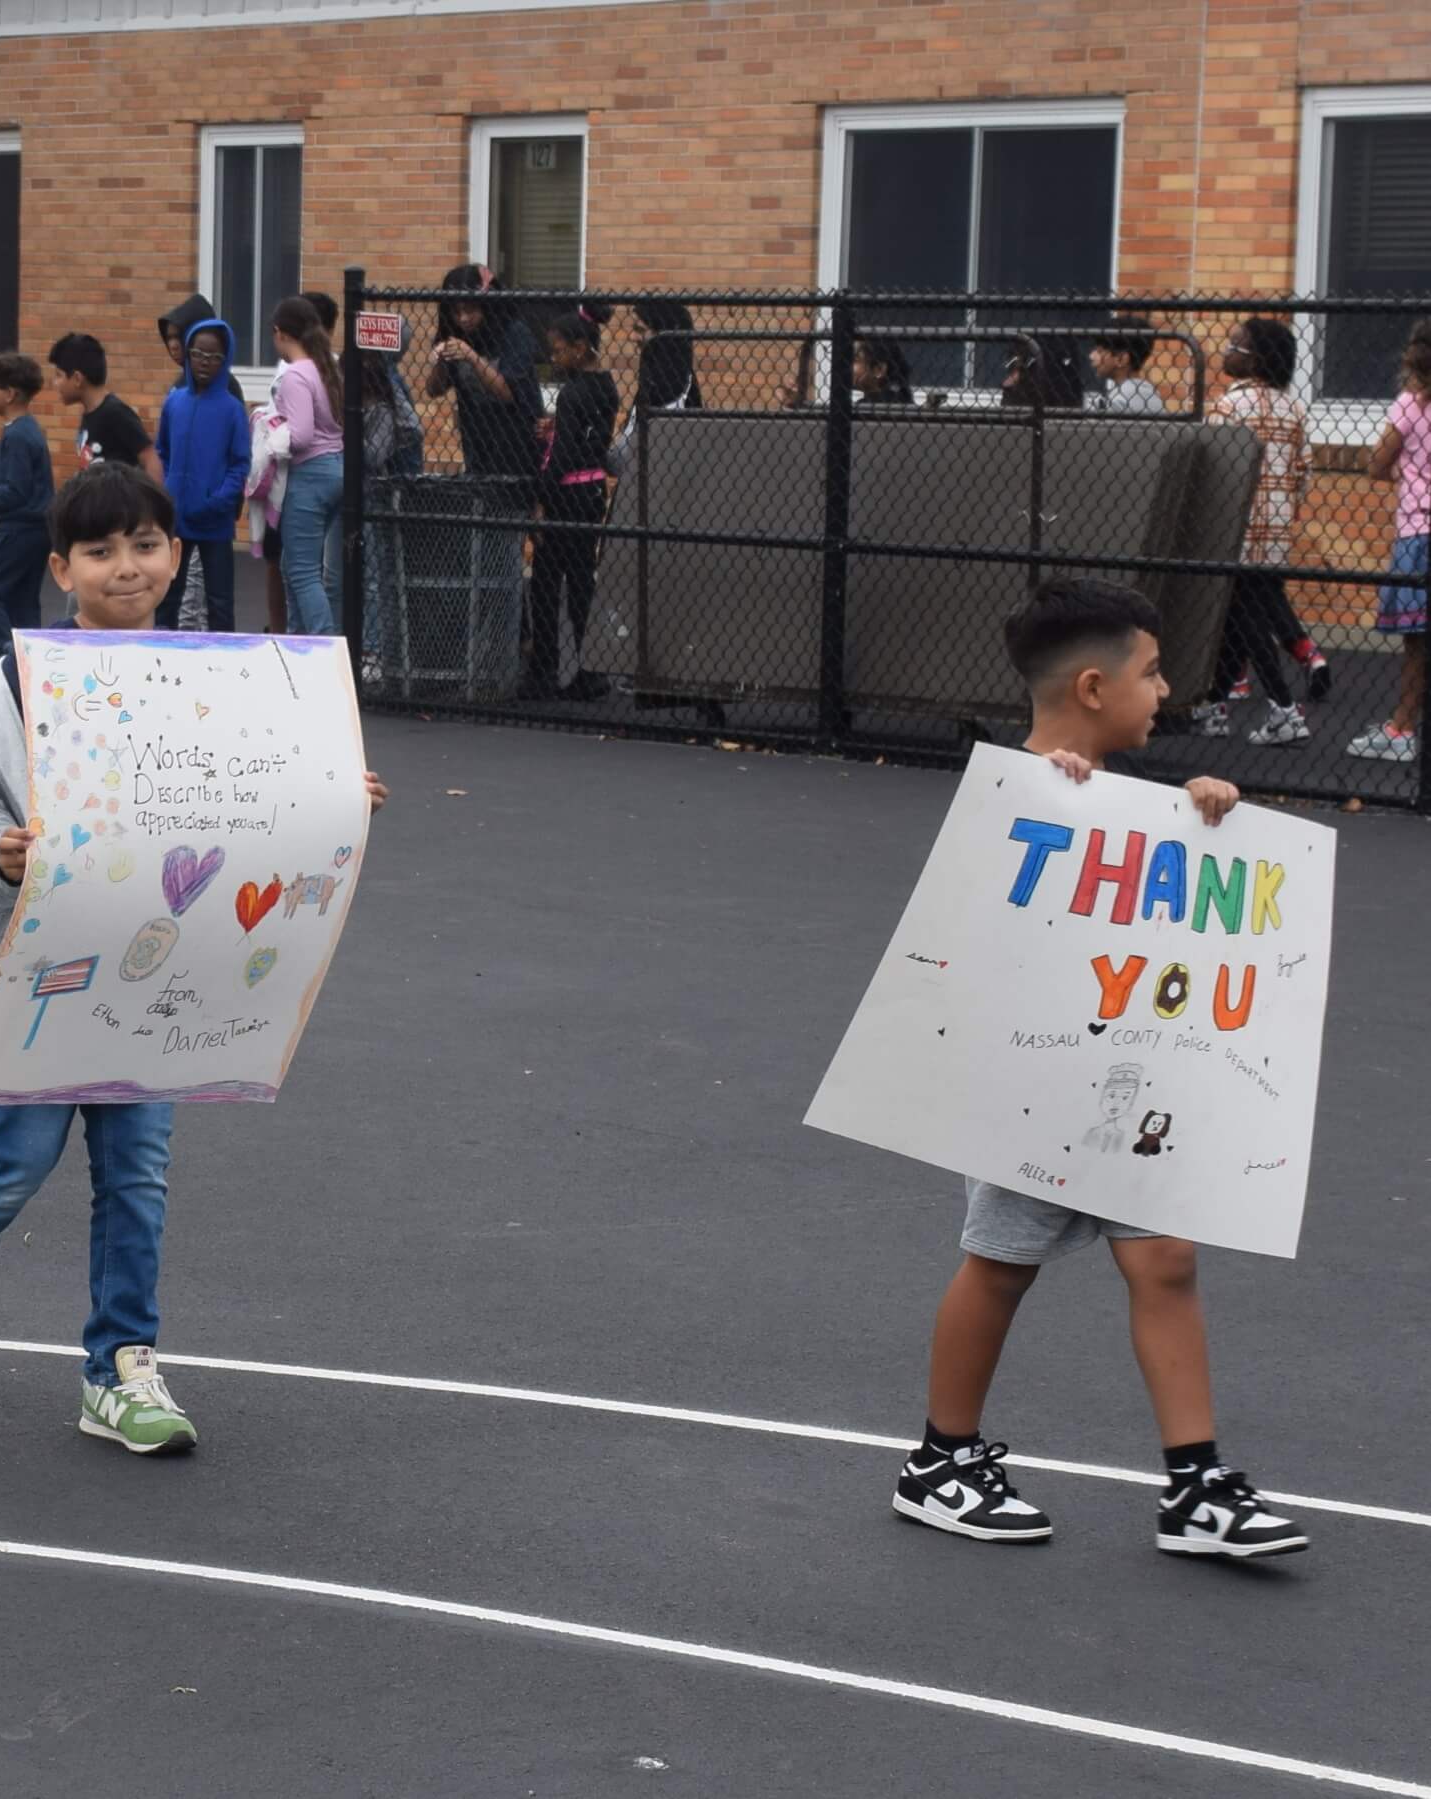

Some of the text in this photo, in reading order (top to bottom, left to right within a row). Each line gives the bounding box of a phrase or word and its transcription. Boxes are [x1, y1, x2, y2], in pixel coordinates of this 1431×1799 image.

[127, 733, 214, 771] Words
[233, 783, 259, 803] how
[135, 810, 221, 836] appreciated
[1007, 817, 1285, 936] THANK
[1090, 953, 1257, 1032] YOU
[1009, 1029, 1081, 1049] NASSAU
[1110, 1029, 1163, 1049] CONTY
